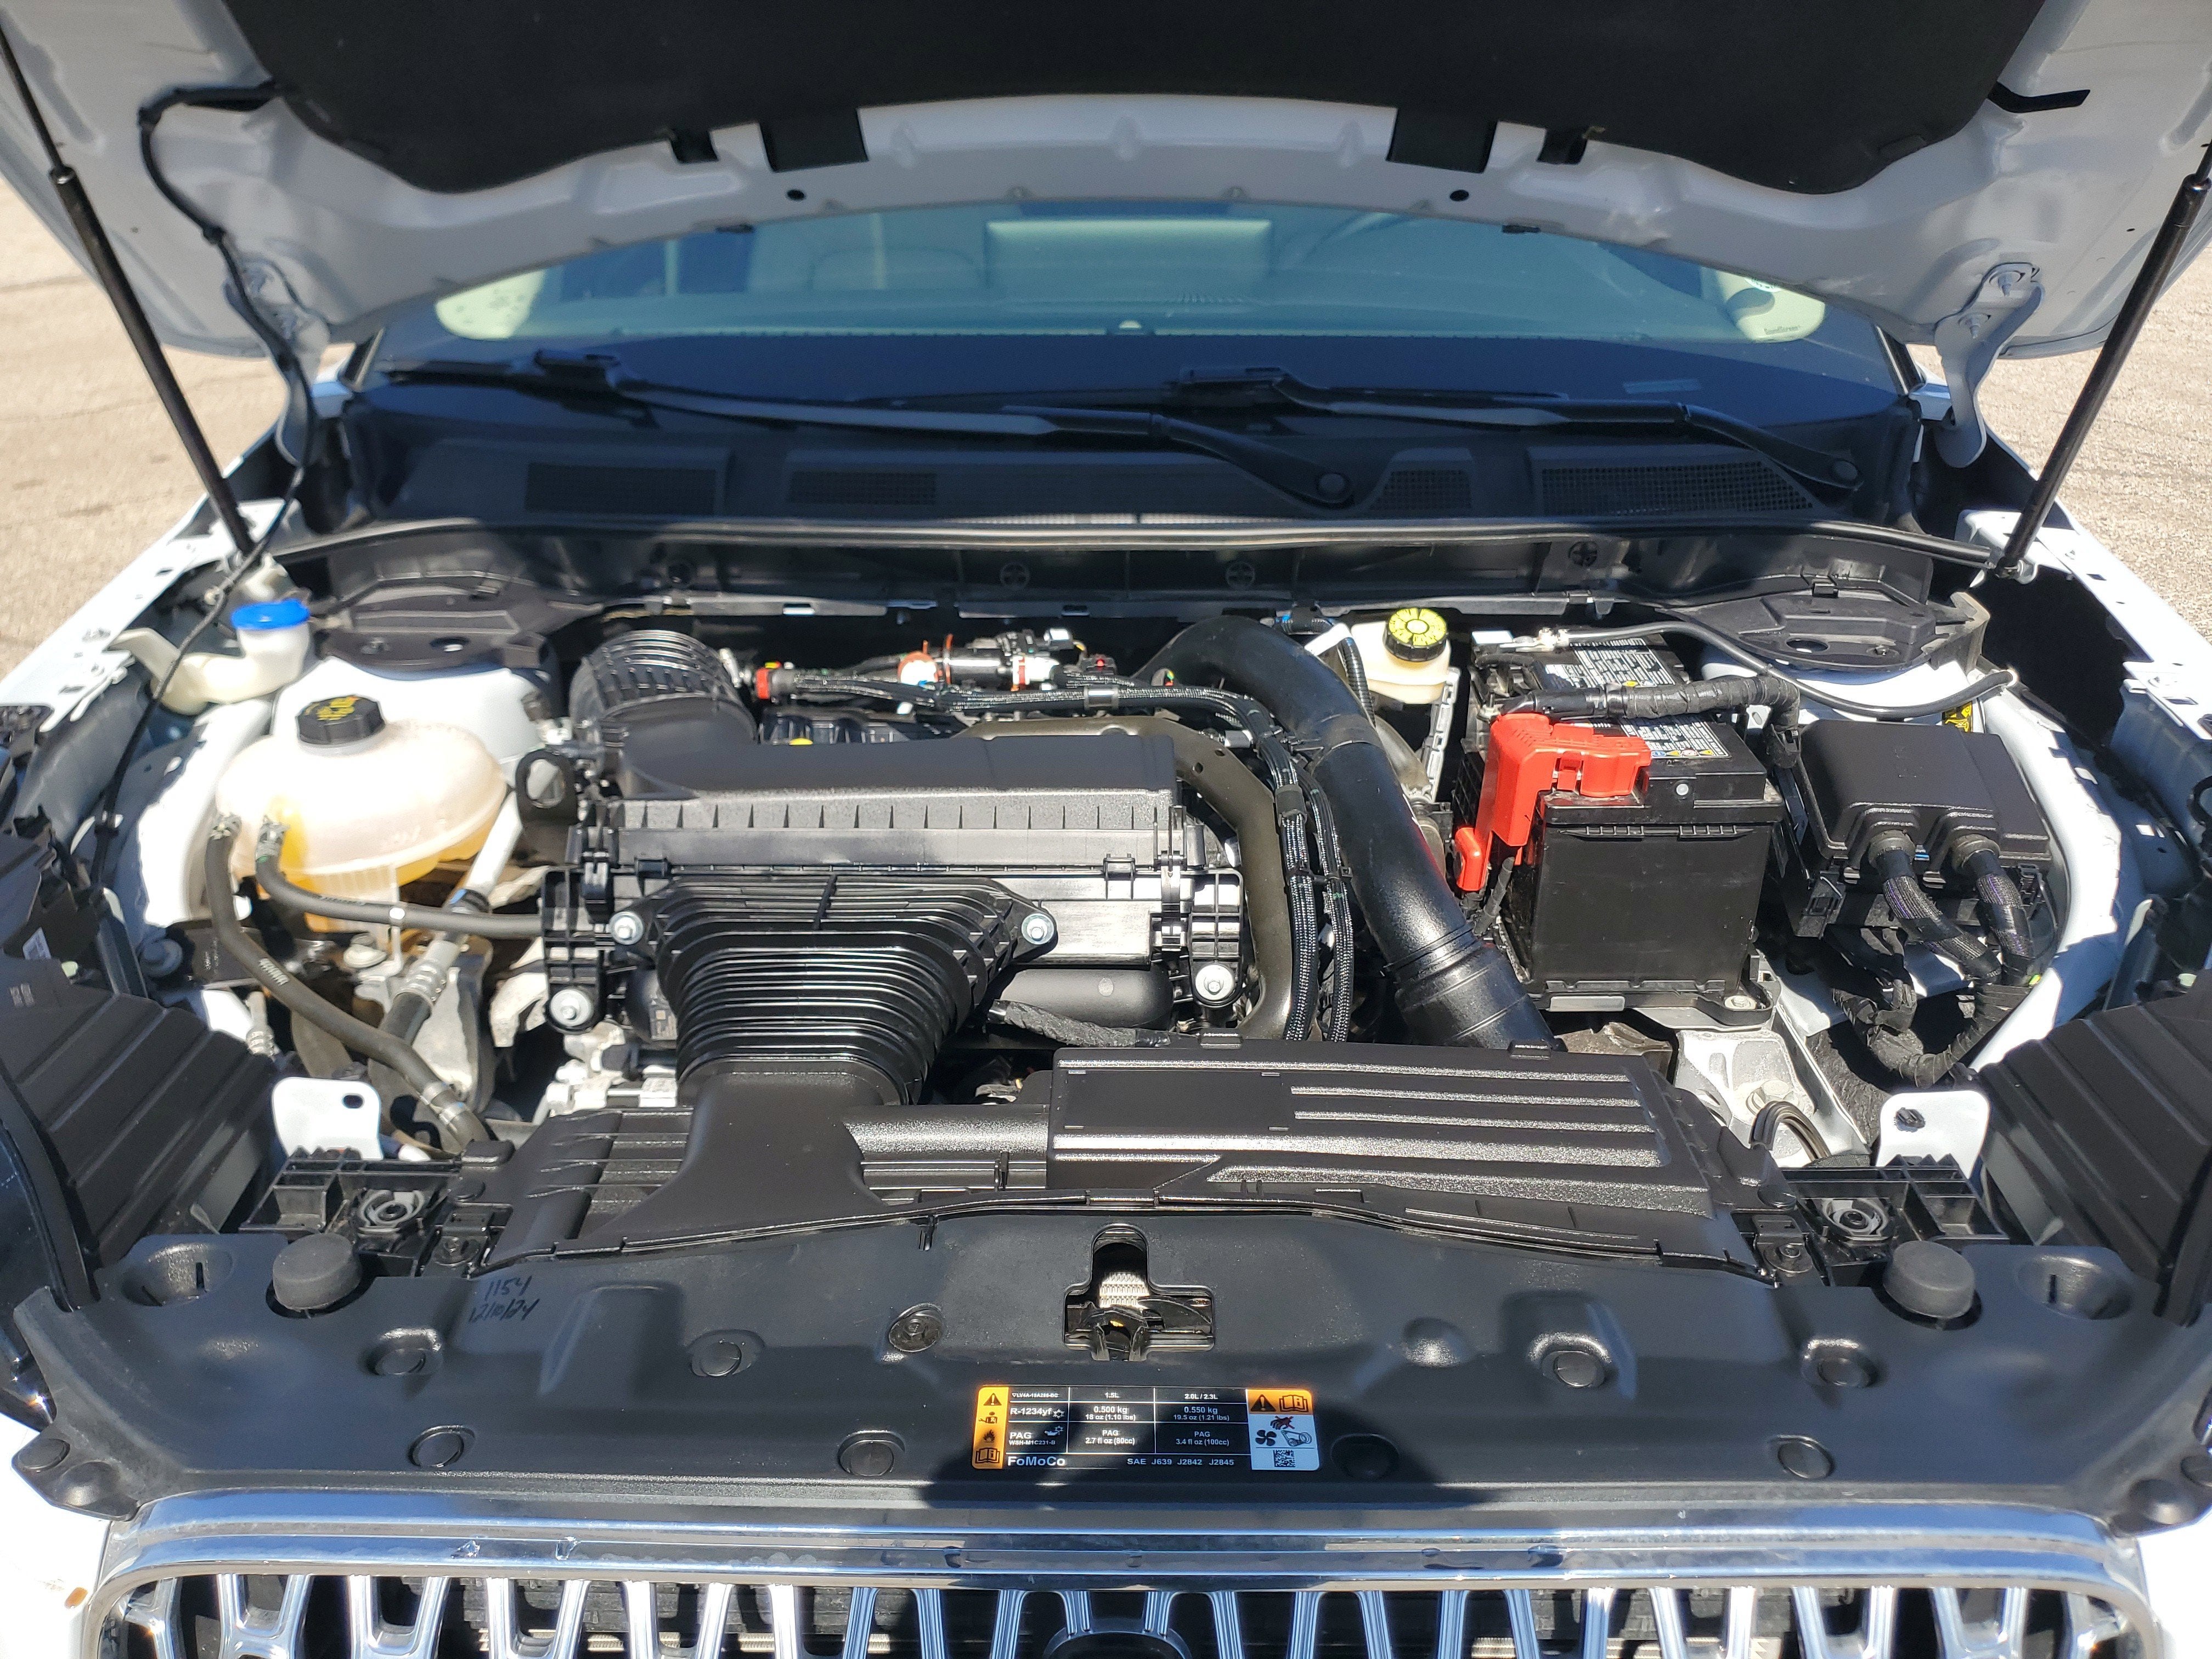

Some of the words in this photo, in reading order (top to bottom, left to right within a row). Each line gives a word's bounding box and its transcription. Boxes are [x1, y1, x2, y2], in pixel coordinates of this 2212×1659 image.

[1010, 1408, 1052, 1416] R-1234yf
[1117, 1406, 1127, 1414] kg
[1007, 1456, 1066, 1466] FoMoCo
